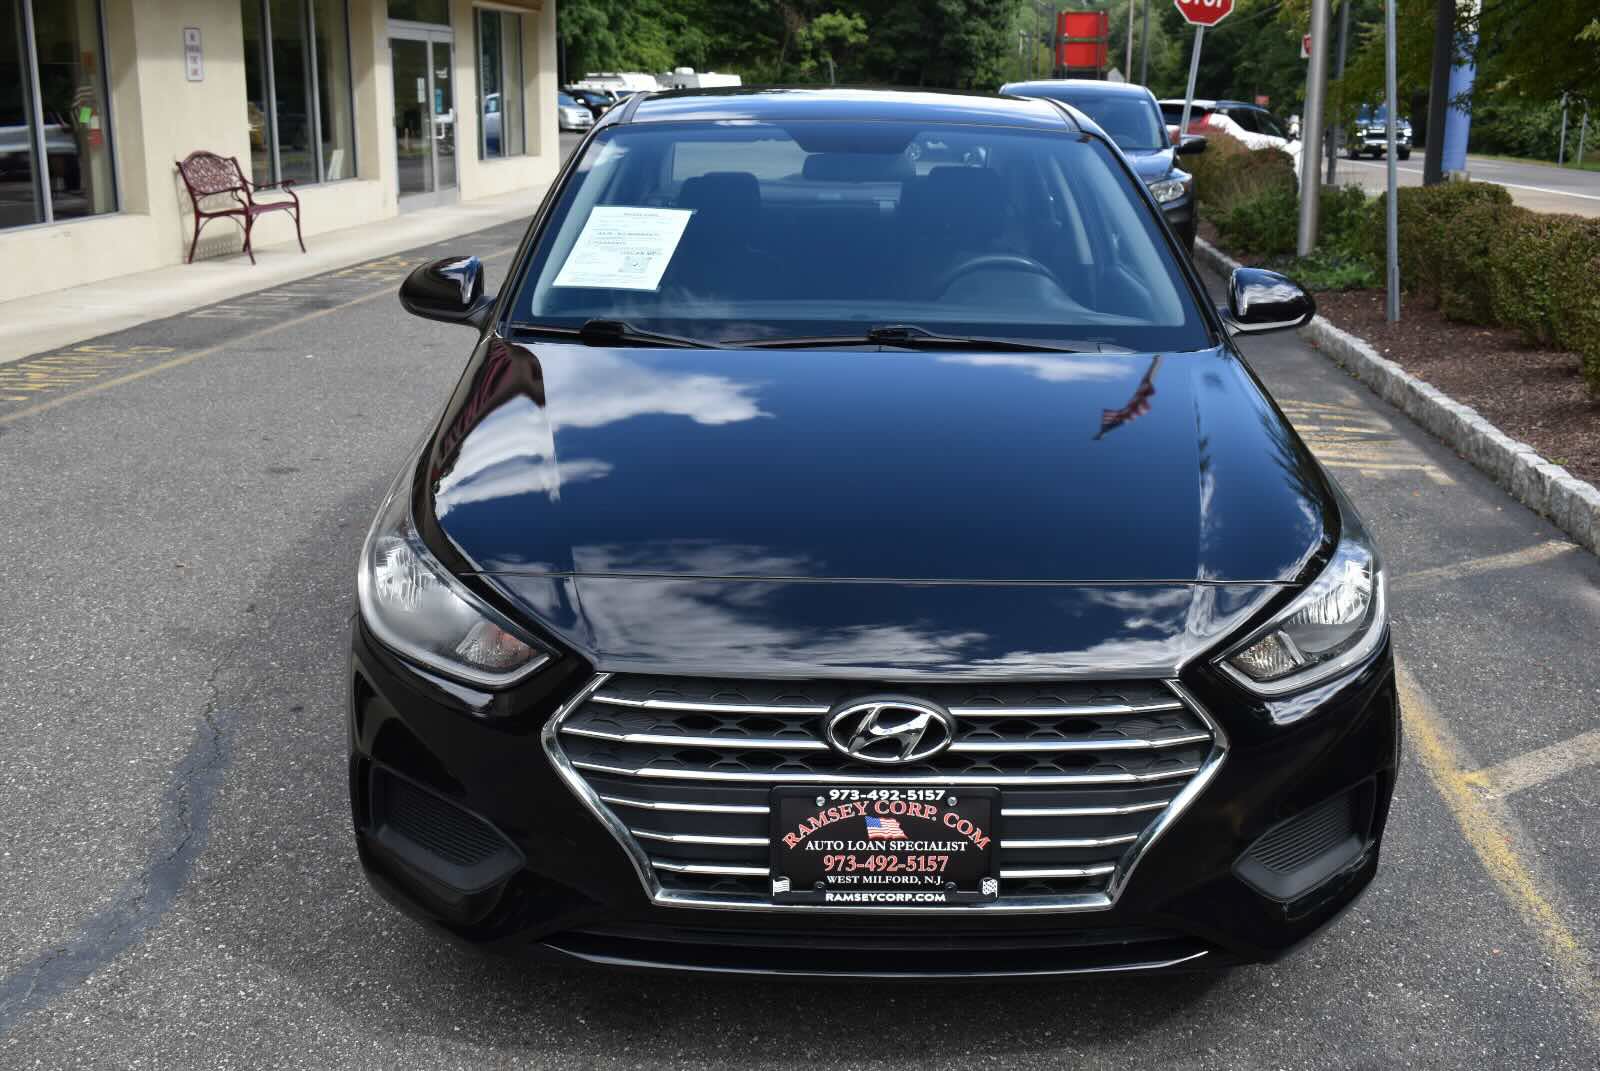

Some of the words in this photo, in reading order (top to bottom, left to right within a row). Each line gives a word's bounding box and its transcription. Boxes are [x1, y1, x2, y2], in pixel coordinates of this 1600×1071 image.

[829, 790, 946, 801] 973-492-5157
[782, 800, 870, 849] RAMSEY
[874, 800, 938, 821] CORP.
[943, 812, 992, 851] COM
[805, 840, 844, 851] AUTO
[847, 840, 887, 851] LOAN
[890, 840, 968, 851] SPECIALIST
[823, 855, 949, 872] 973-492-5157
[826, 876, 861, 884] WEST
[862, 876, 922, 885] MILFORD,
[924, 876, 944, 885] N.J.
[825, 893, 946, 902] RAMSEYCORP.COM
